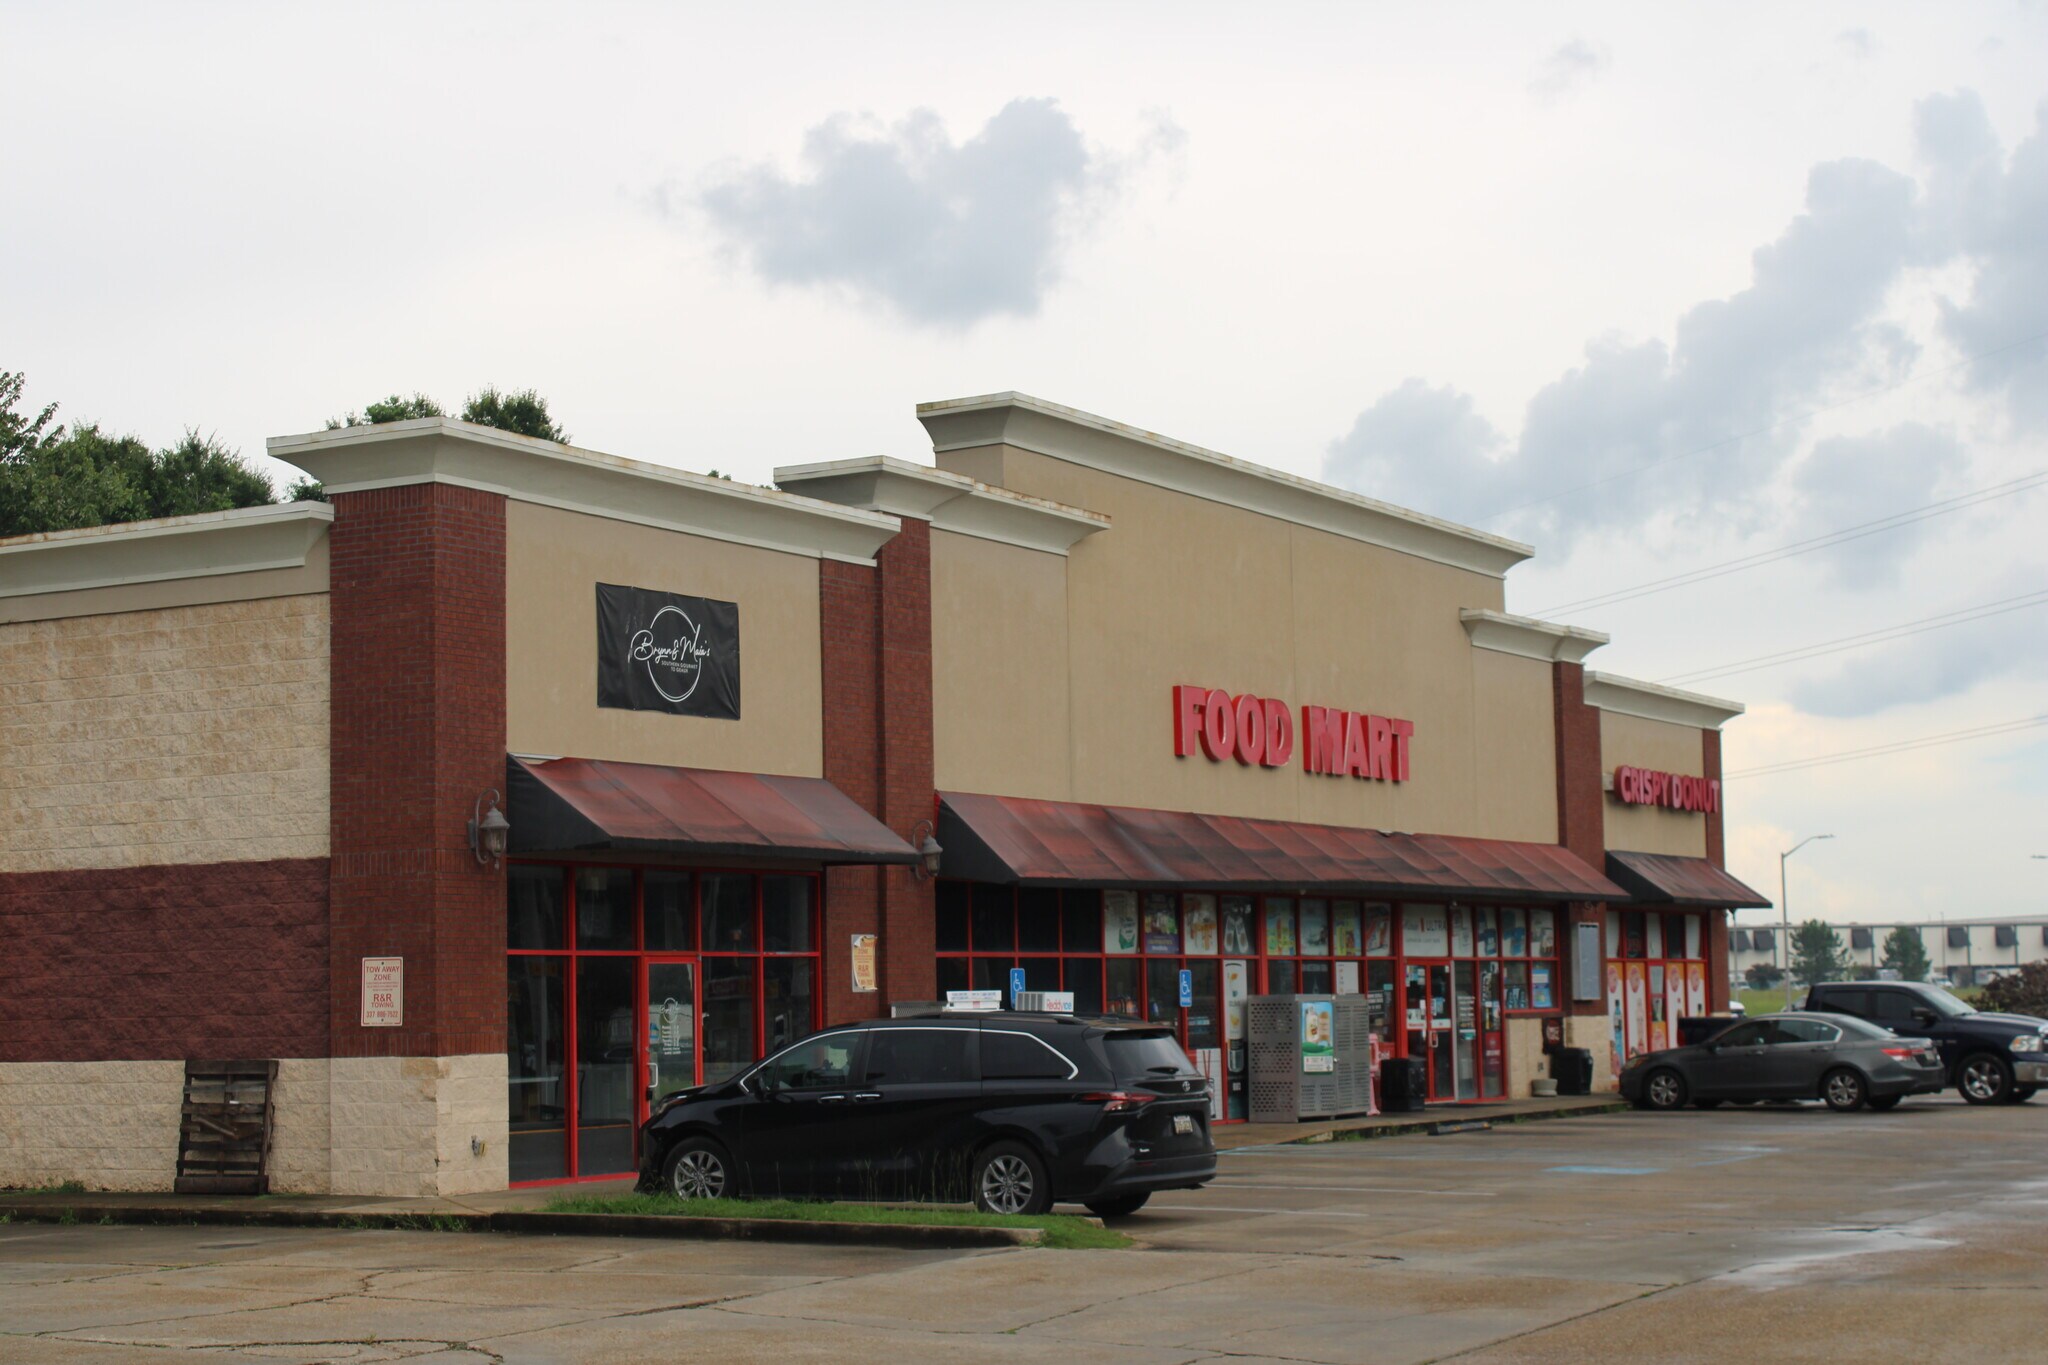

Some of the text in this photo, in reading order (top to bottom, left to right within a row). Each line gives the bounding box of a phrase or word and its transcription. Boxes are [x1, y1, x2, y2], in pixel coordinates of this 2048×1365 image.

[680, 662, 699, 670] GOURMET
[1173, 685, 1414, 781] FOOD MART
[1614, 765, 1720, 814] CRISPY DONUT
[373, 993, 392, 1002] R&R
